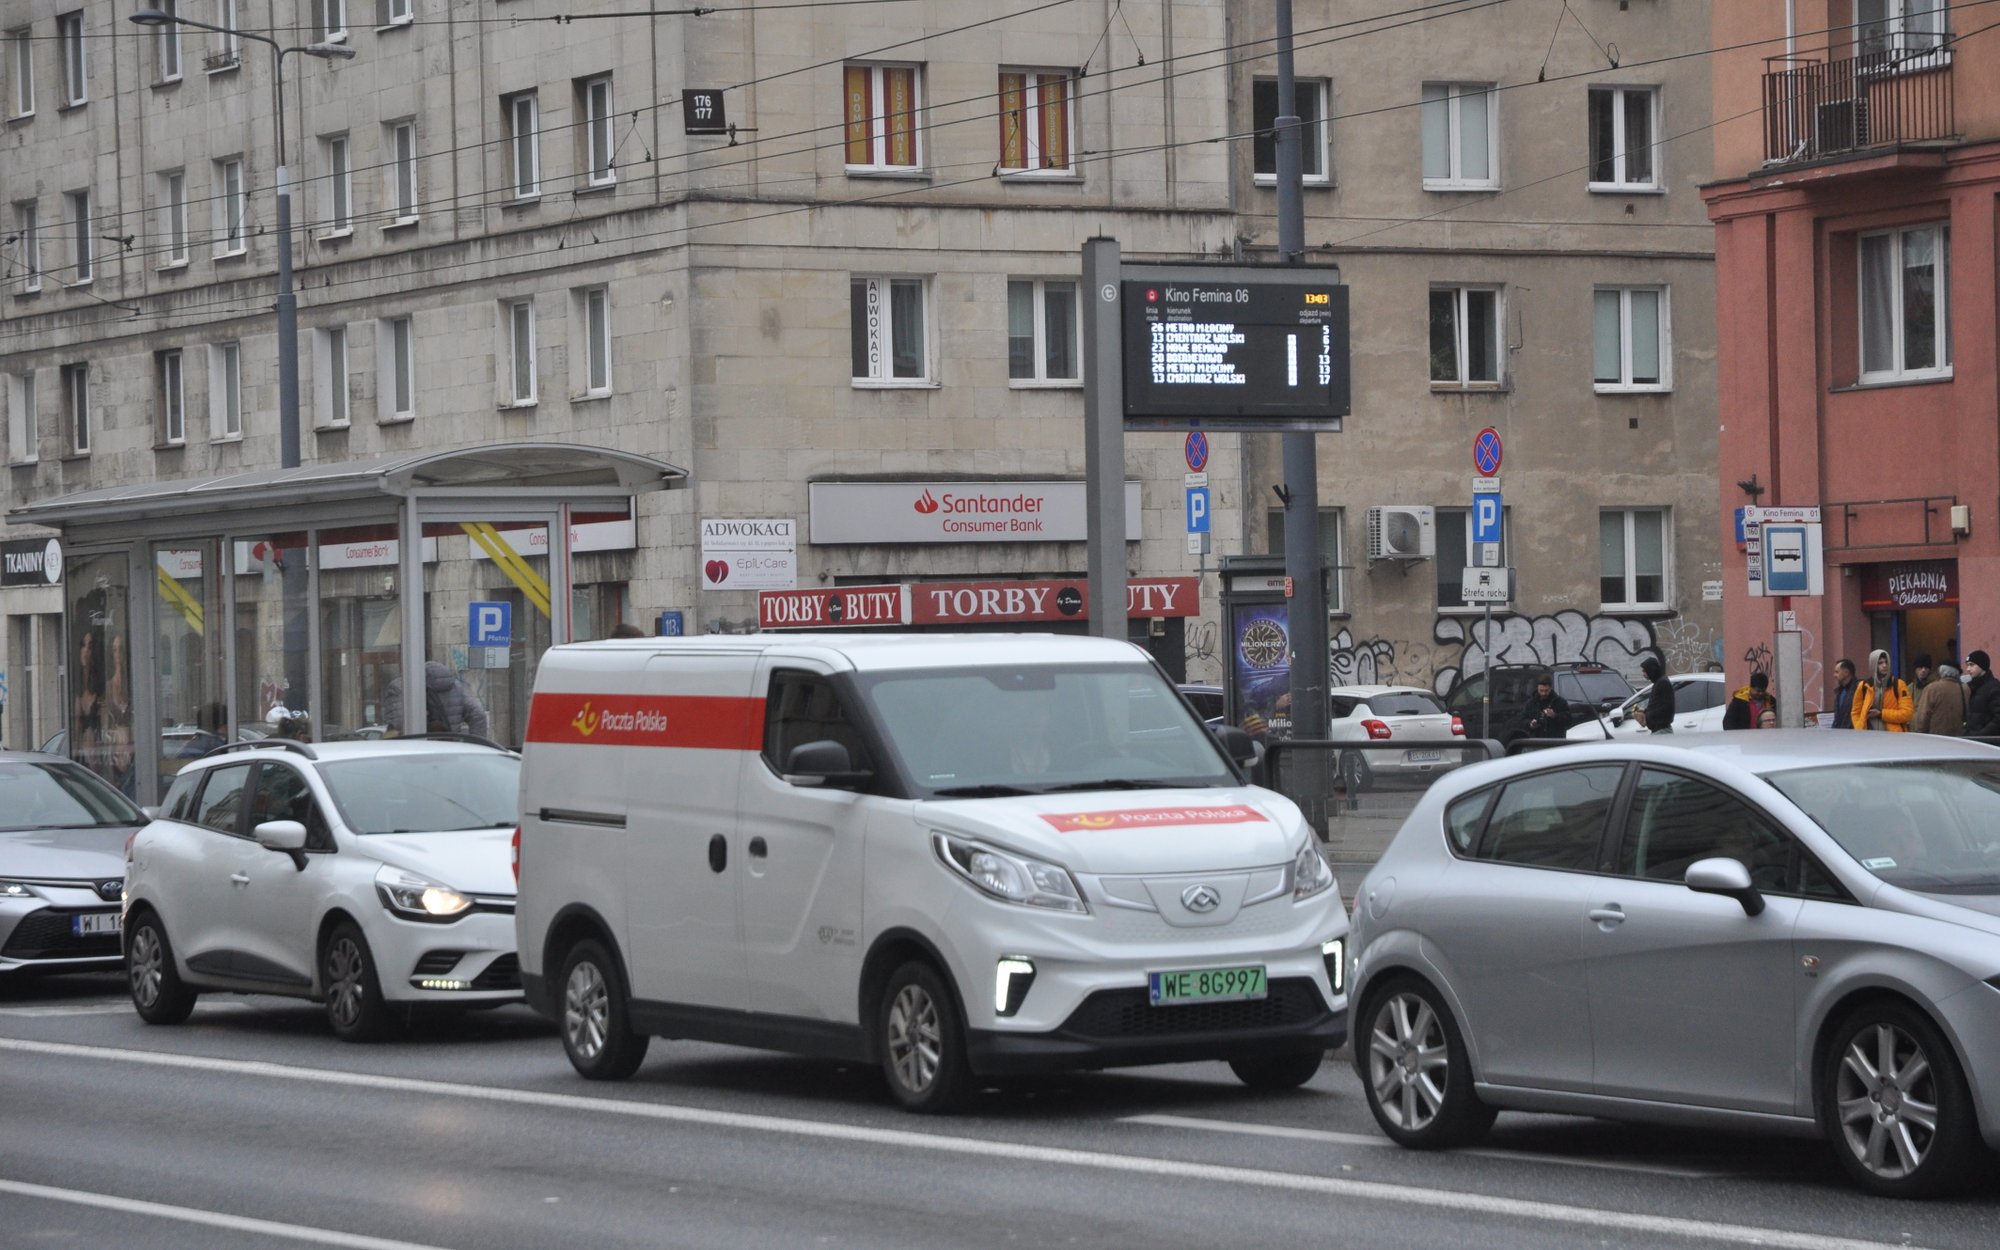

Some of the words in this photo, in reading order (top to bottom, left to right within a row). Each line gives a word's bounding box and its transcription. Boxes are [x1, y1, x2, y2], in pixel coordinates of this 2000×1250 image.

[694, 95, 712, 106] 176
[695, 108, 712, 119] 177
[853, 93, 862, 132] DOMY
[1165, 288, 1190, 302] Kino
[1192, 288, 1232, 302] Femina
[1235, 288, 1249, 303] 06
[1305, 294, 1328, 304] 13:03
[1299, 310, 1318, 318] odjazd
[868, 281, 878, 375] ADWOKACI
[1151, 323, 1164, 332] 26
[1166, 323, 1195, 332] METRO
[1322, 325, 1330, 334] 5
[1152, 333, 1164, 342] 13
[1213, 334, 1245, 344] WOLSKI
[1322, 335, 1330, 344] 6
[1152, 343, 1164, 352] 23
[1324, 345, 1330, 355] 7
[1152, 354, 1164, 363] 20
[1318, 354, 1330, 364] 13
[1152, 364, 1164, 373] 26
[1166, 364, 1196, 374] METRO
[1318, 364, 1330, 374] 13
[1153, 374, 1165, 384] 13
[1214, 374, 1246, 384] WOLSKI
[1318, 374, 1330, 384] 17
[942, 493, 1044, 514] Santander
[1191, 492, 1205, 528] P
[942, 519, 1008, 532] Consumer
[1010, 518, 1042, 532] Bank
[1479, 499, 1496, 537] P
[704, 522, 790, 536] ADWOKACI
[5, 552, 44, 573] TKANINY
[1888, 572, 1947, 594] PIEKARNIA
[1464, 588, 1484, 597] Strefa
[1487, 588, 1506, 598] ruchu
[1899, 590, 1938, 606] Oskroba
[764, 595, 825, 622] TORBY
[846, 592, 897, 620] BUTY
[930, 587, 1050, 617] TORBY
[479, 607, 502, 641] P
[666, 618, 676, 636] 113
[602, 710, 634, 730] Poczta
[634, 710, 668, 732] Polska
[1119, 812, 1183, 823] Poczta
[1185, 808, 1248, 819] Polska
[84, 916, 100, 931] WI
[1165, 973, 1191, 998] WE
[1200, 969, 1260, 995] 8G997
